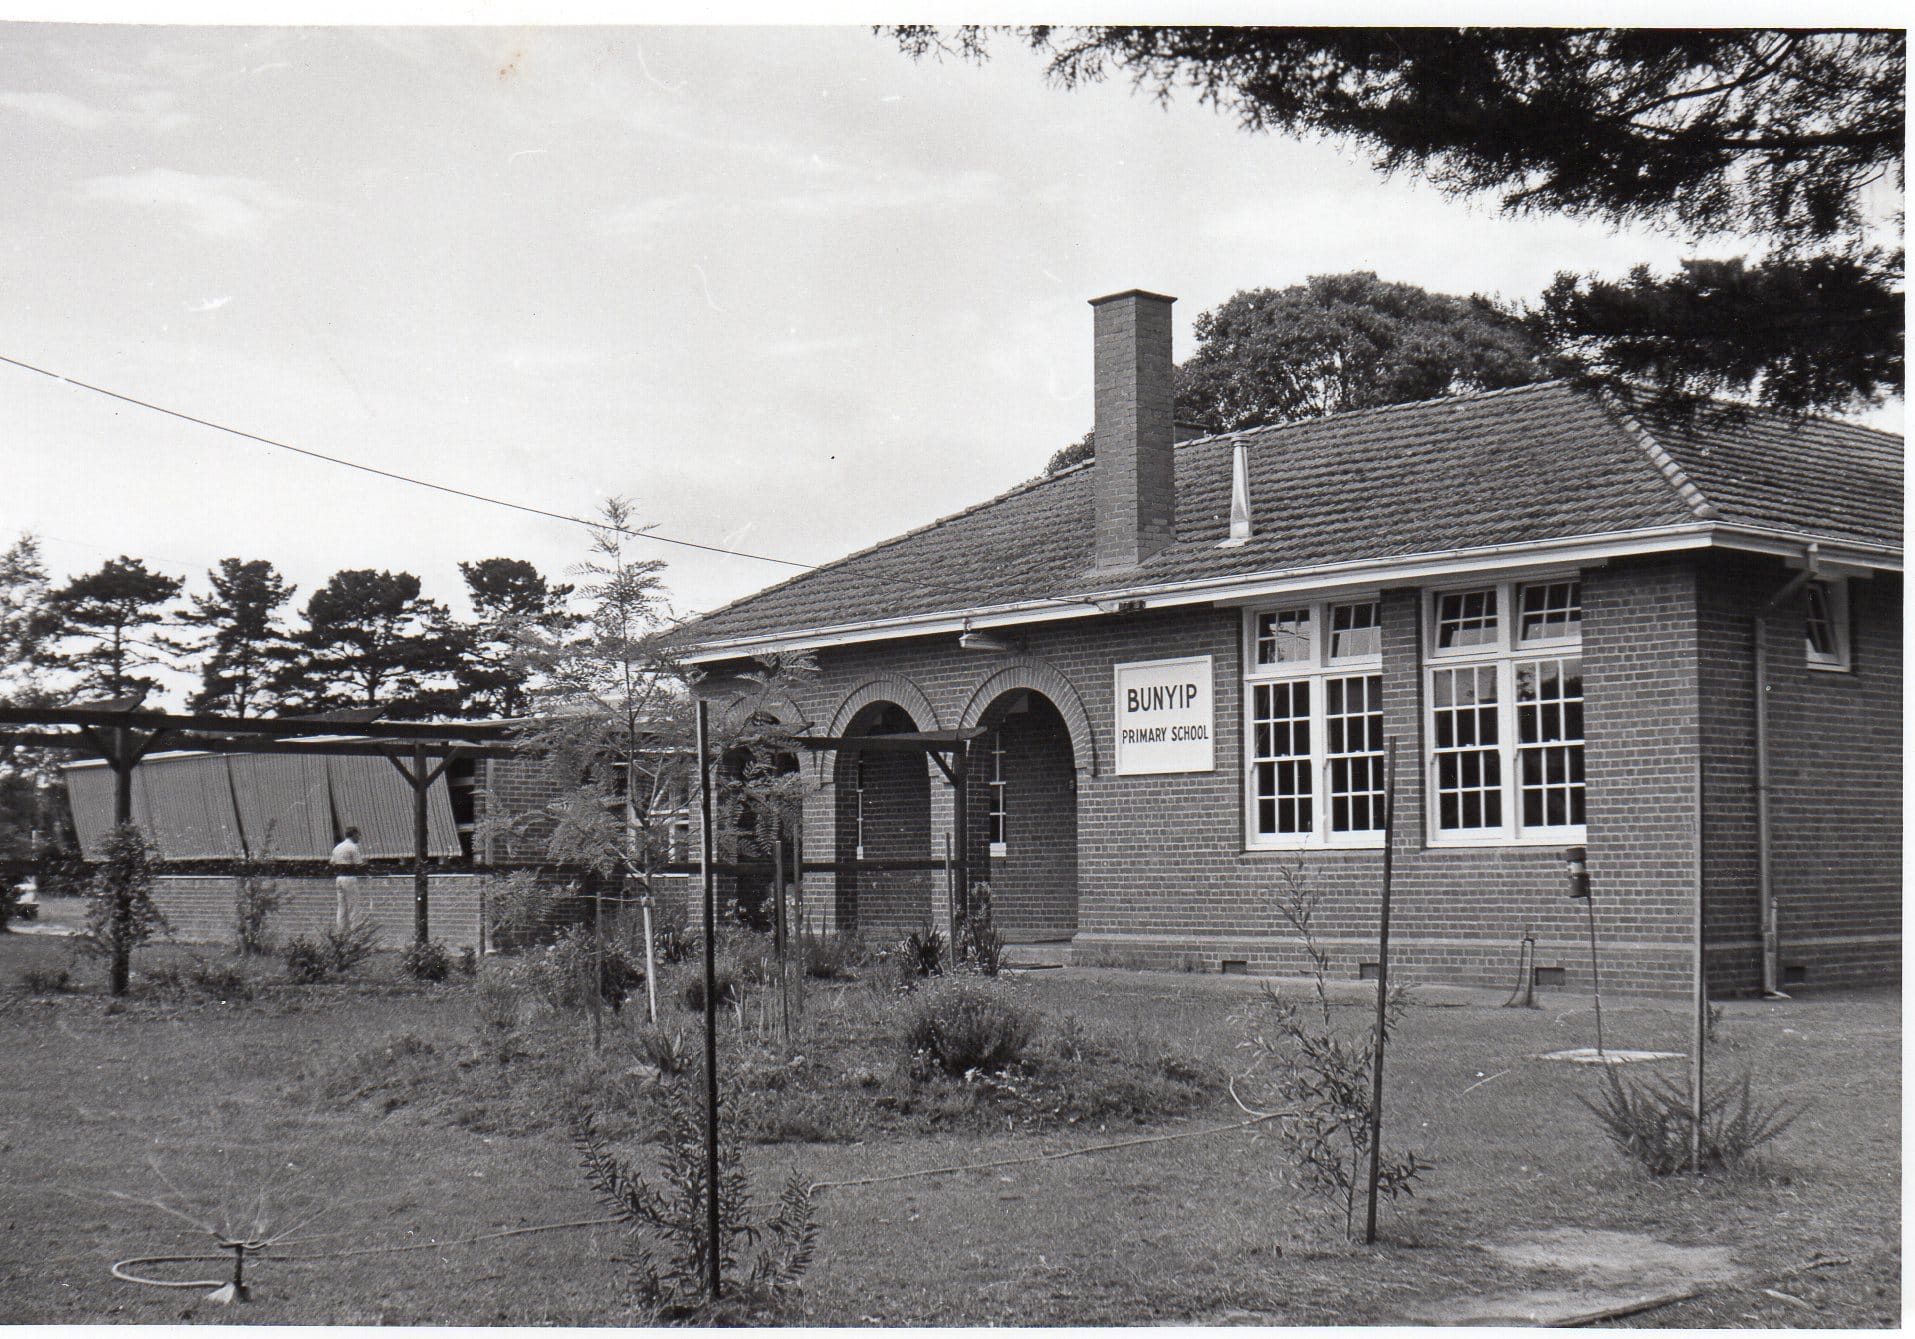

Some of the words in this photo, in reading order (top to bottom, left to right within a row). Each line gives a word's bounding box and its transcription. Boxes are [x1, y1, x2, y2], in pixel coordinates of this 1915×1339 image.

[1127, 683, 1197, 713] BUNYIP
[1122, 727, 1167, 744] PRIMARY
[1171, 725, 1209, 742] SCHOOL
